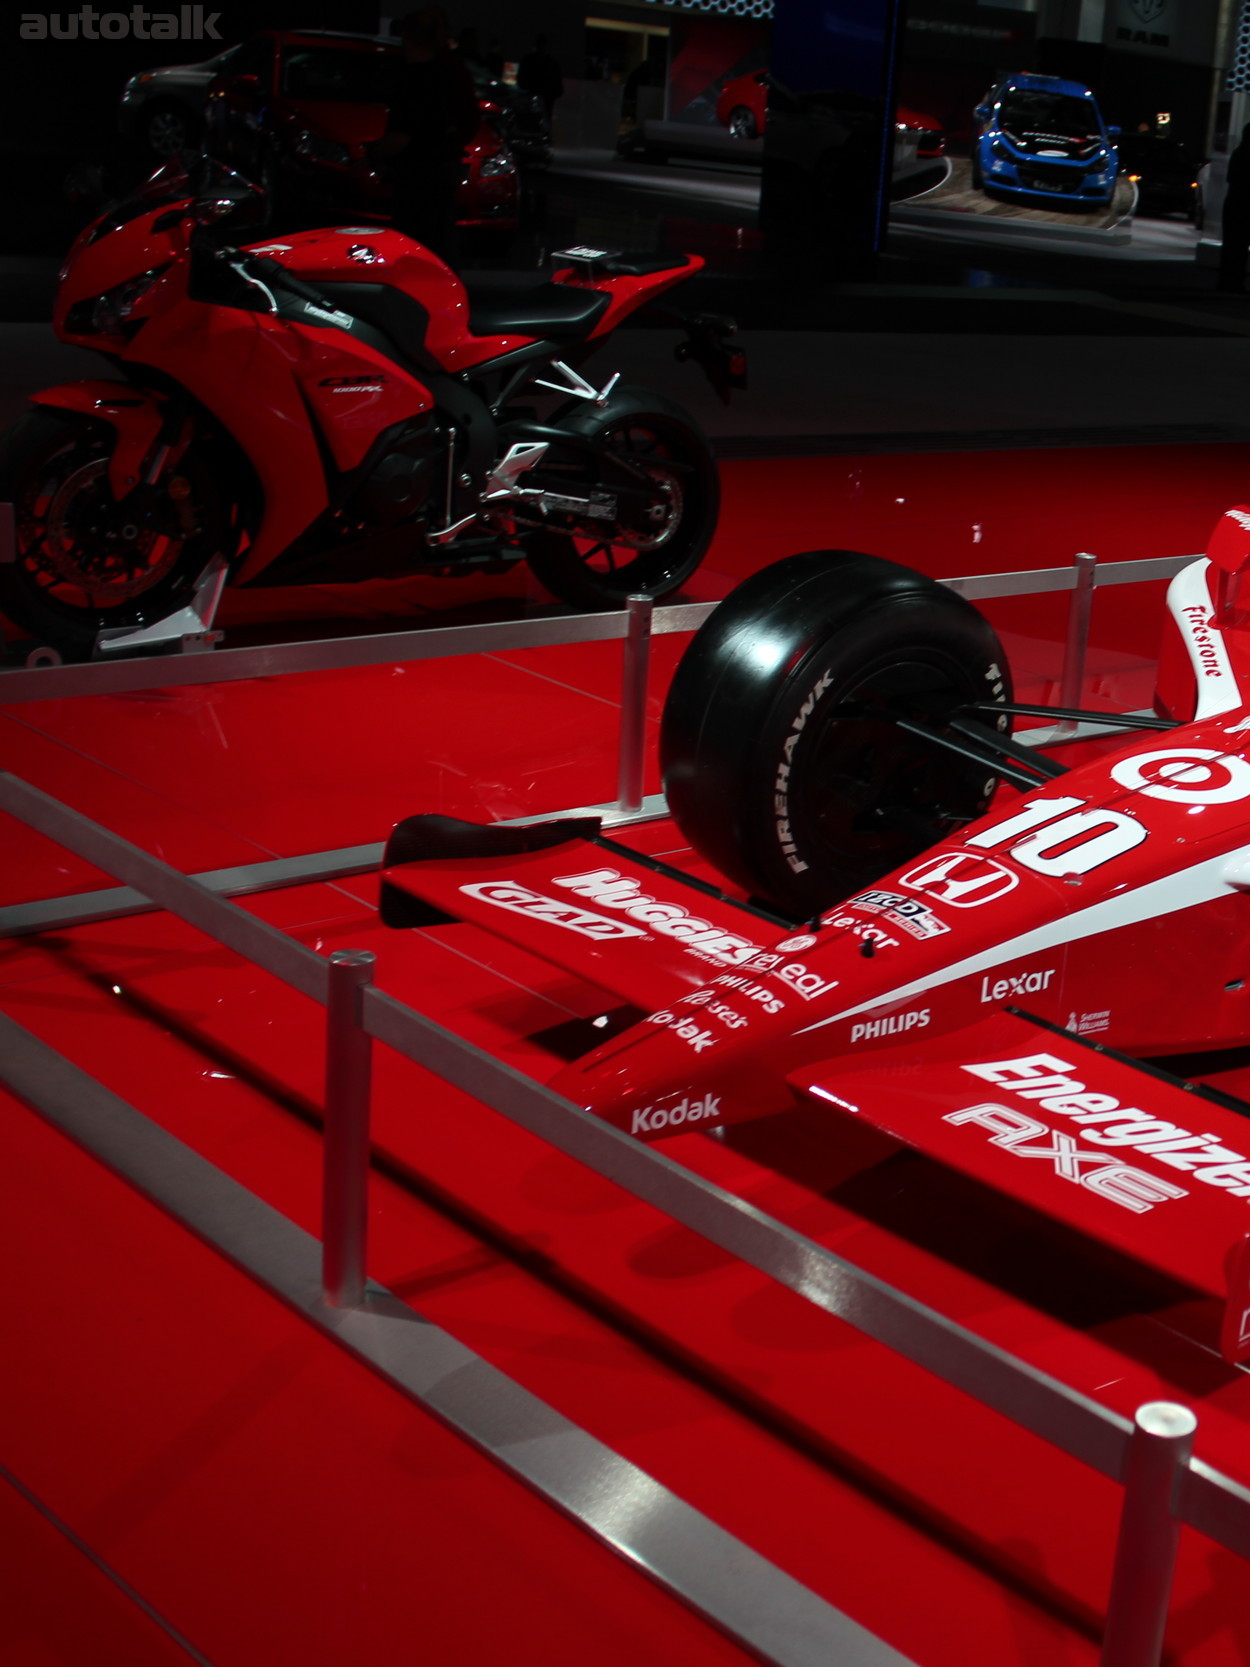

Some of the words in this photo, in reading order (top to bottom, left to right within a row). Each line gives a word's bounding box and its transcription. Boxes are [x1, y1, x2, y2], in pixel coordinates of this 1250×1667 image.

[1116, 26, 1170, 47] RAM
[1182, 605, 1223, 678] Firestone
[774, 668, 835, 875] FIREHAWK
[963, 796, 1149, 879] 10
[478, 885, 624, 936] GLAD
[551, 867, 767, 966] HUGGIES
[710, 974, 786, 1014] PHILIPS
[980, 968, 1056, 1003] Lexar
[850, 1008, 932, 1044] PHILIPS
[630, 1092, 722, 1135] Kodak
[940, 1102, 1190, 1214] AXE
